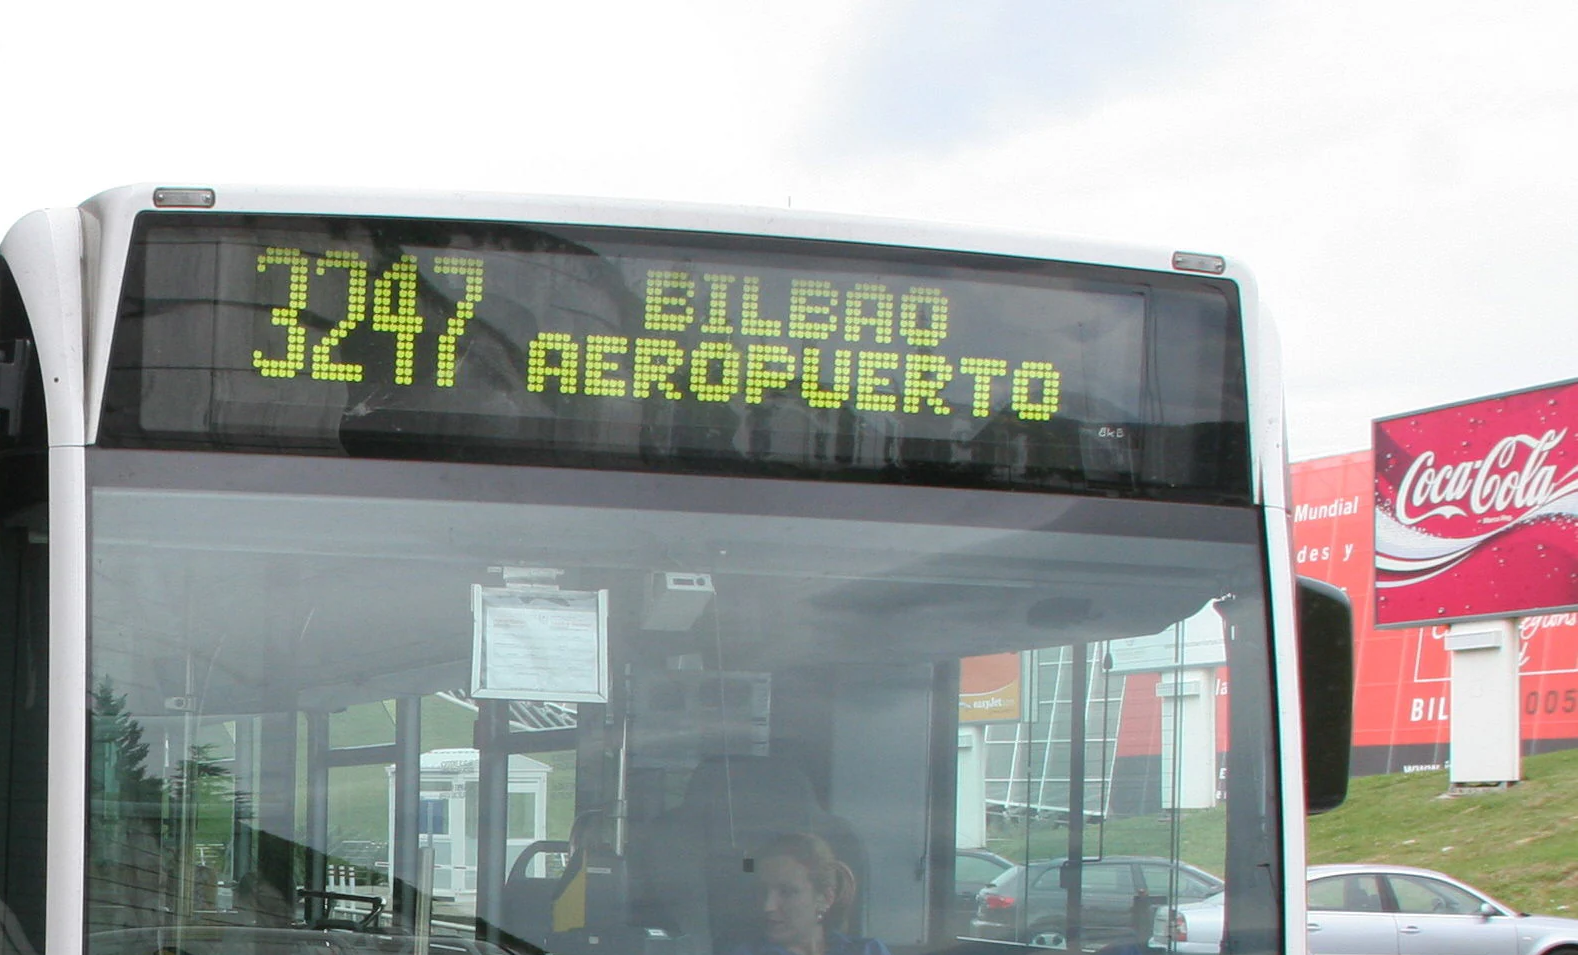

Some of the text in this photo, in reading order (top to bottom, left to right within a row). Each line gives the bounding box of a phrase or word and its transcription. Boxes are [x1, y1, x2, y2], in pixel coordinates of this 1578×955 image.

[252, 246, 485, 388] 3247
[644, 269, 948, 347] BILBAO
[526, 331, 1061, 422] AEROPUERTO
[1294, 496, 1359, 523] Mundial
[1395, 426, 1569, 526] Coca-Cola
[1342, 542, 1353, 562] y
